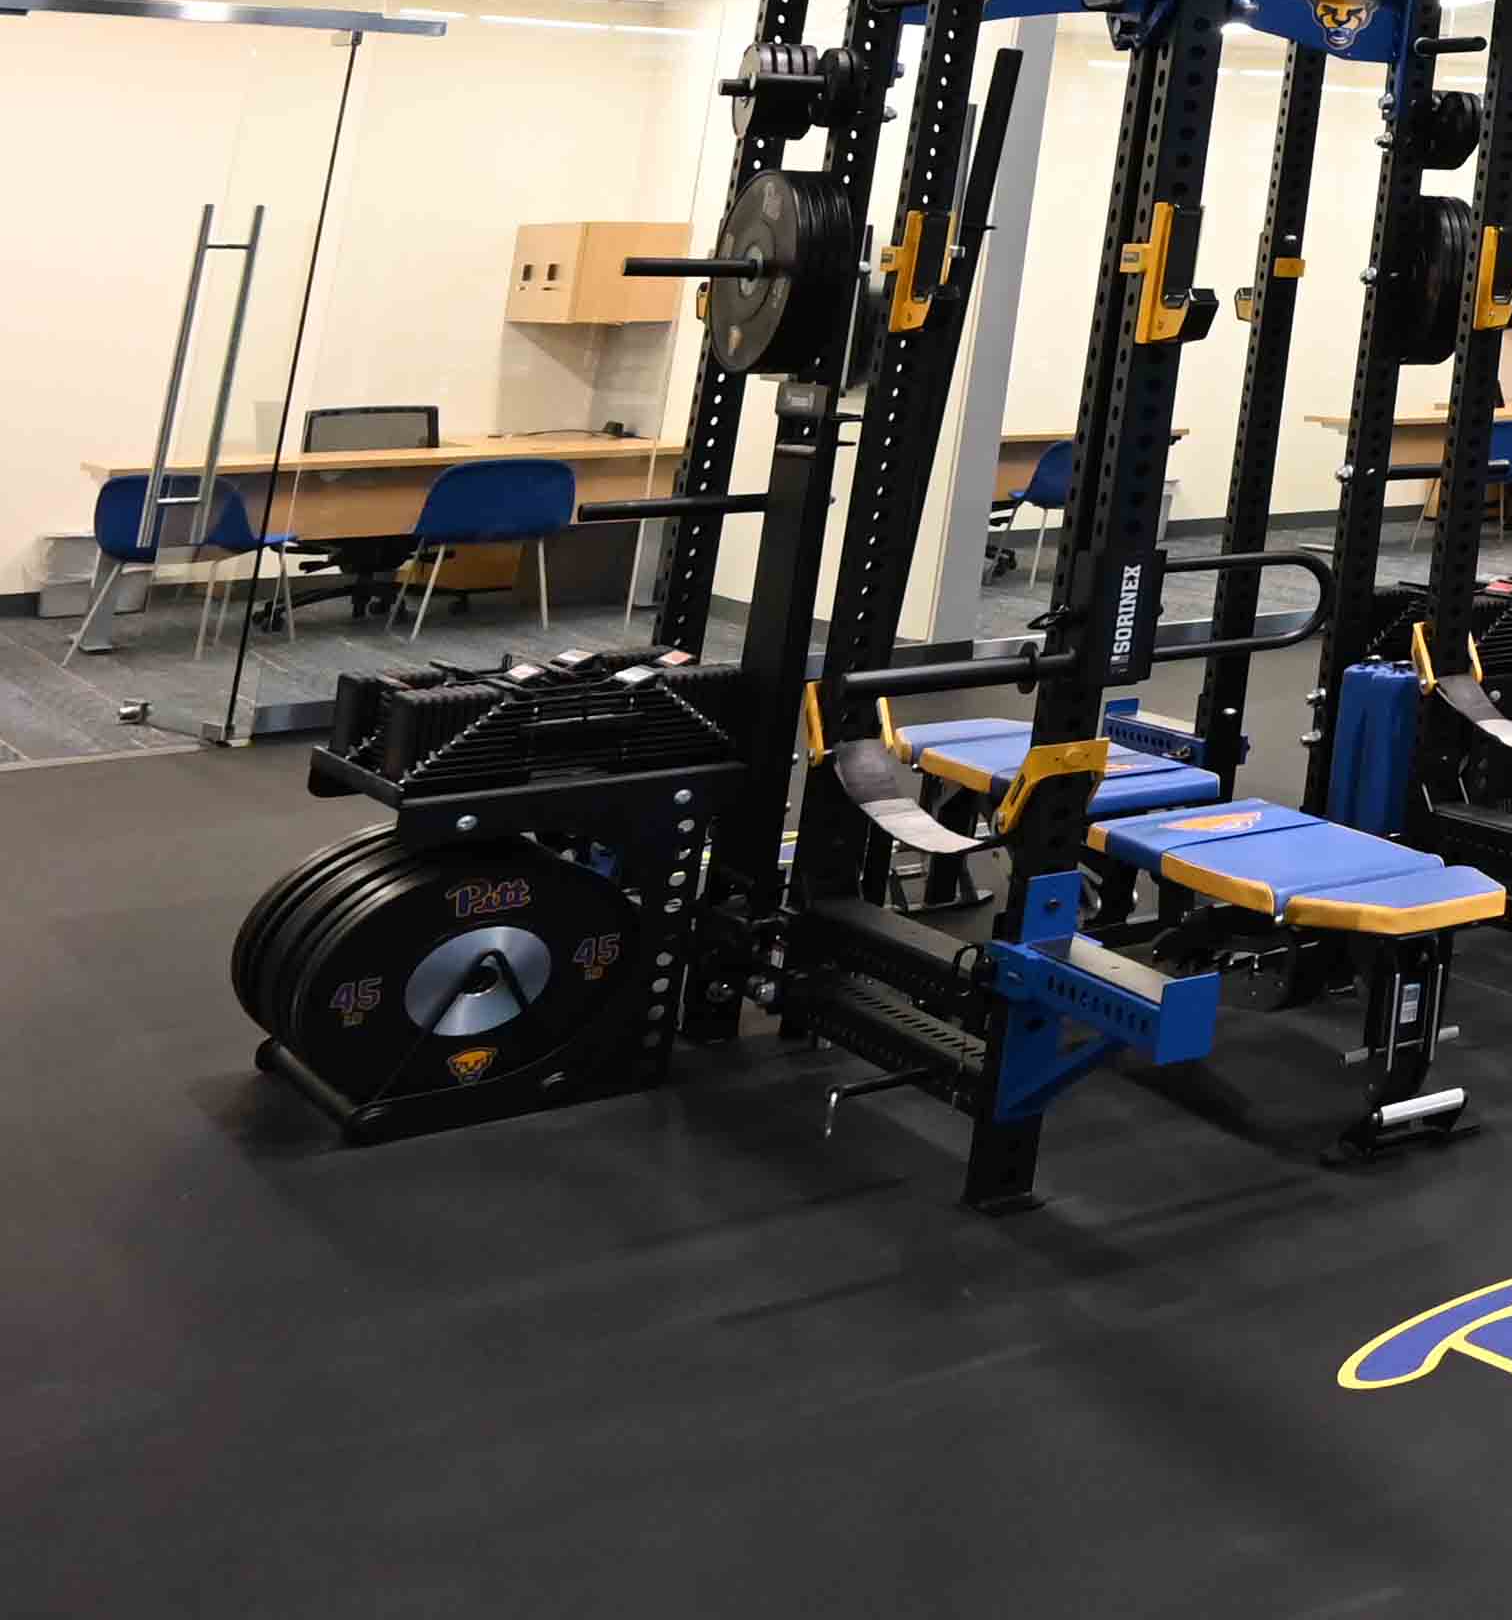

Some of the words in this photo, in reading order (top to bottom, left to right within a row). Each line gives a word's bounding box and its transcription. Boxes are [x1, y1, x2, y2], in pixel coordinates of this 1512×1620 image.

[1112, 563, 1142, 654] SORINEX
[446, 878, 532, 918] Pitt
[573, 932, 621, 968] 45
[329, 976, 383, 1014] 45
